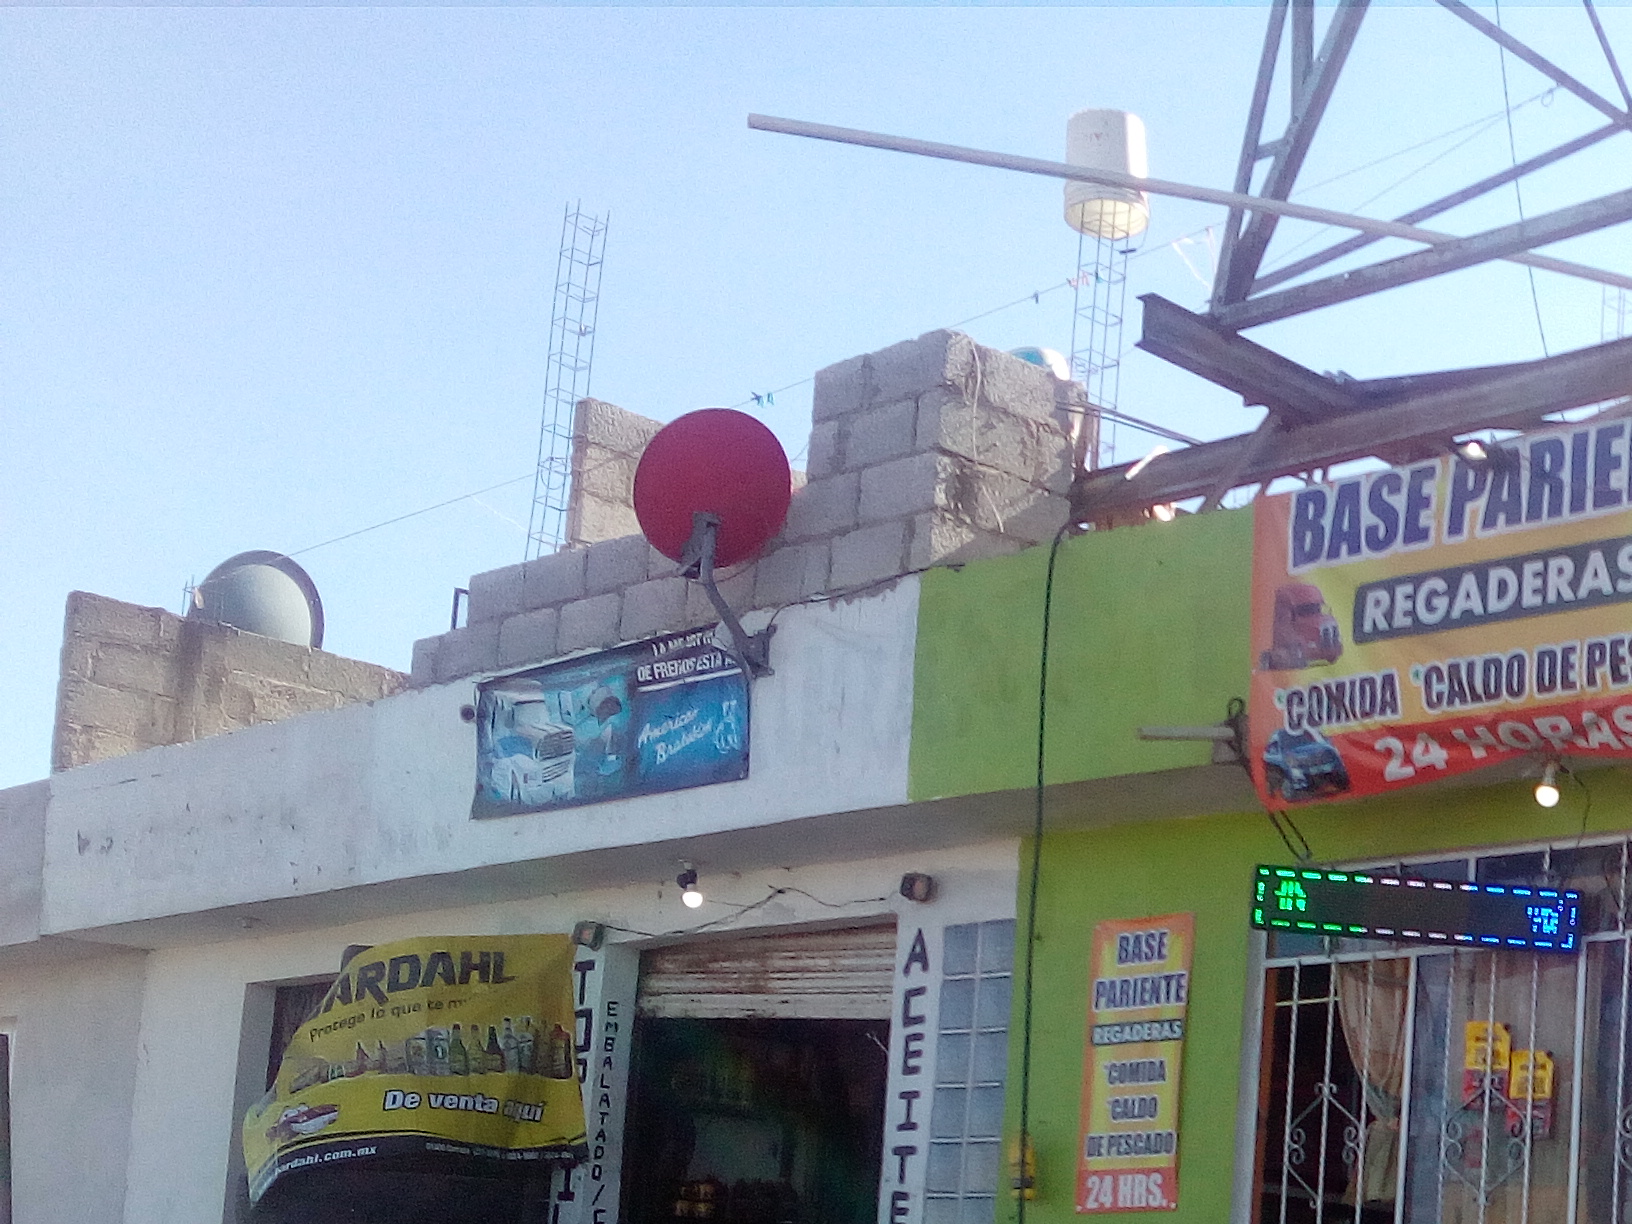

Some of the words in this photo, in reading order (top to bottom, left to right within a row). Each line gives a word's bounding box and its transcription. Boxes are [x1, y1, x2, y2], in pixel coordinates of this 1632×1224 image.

[1289, 464, 1436, 573] BASE
[1284, 670, 1400, 733] COMIDA
[1421, 649, 1528, 712] CALDO
[1535, 642, 1584, 700] DE
[1374, 733, 1448, 783] 24
[1116, 930, 1168, 966] BASE
[1093, 971, 1188, 1012] PARIENTE
[309, 1011, 365, 1043] Protege
[371, 1002, 385, 1019] lo
[391, 1001, 422, 1018] que
[1094, 1021, 1182, 1044] REGADERAS
[1107, 1059, 1167, 1084] COMIDA
[383, 1090, 420, 1111] De
[428, 1092, 498, 1113] venta
[1110, 1096, 1158, 1122] CALDO
[1086, 1135, 1105, 1159] DE
[1107, 1130, 1176, 1157] PESCADO
[1087, 1175, 1113, 1209] 24
[1118, 1173, 1167, 1208] HRS.
